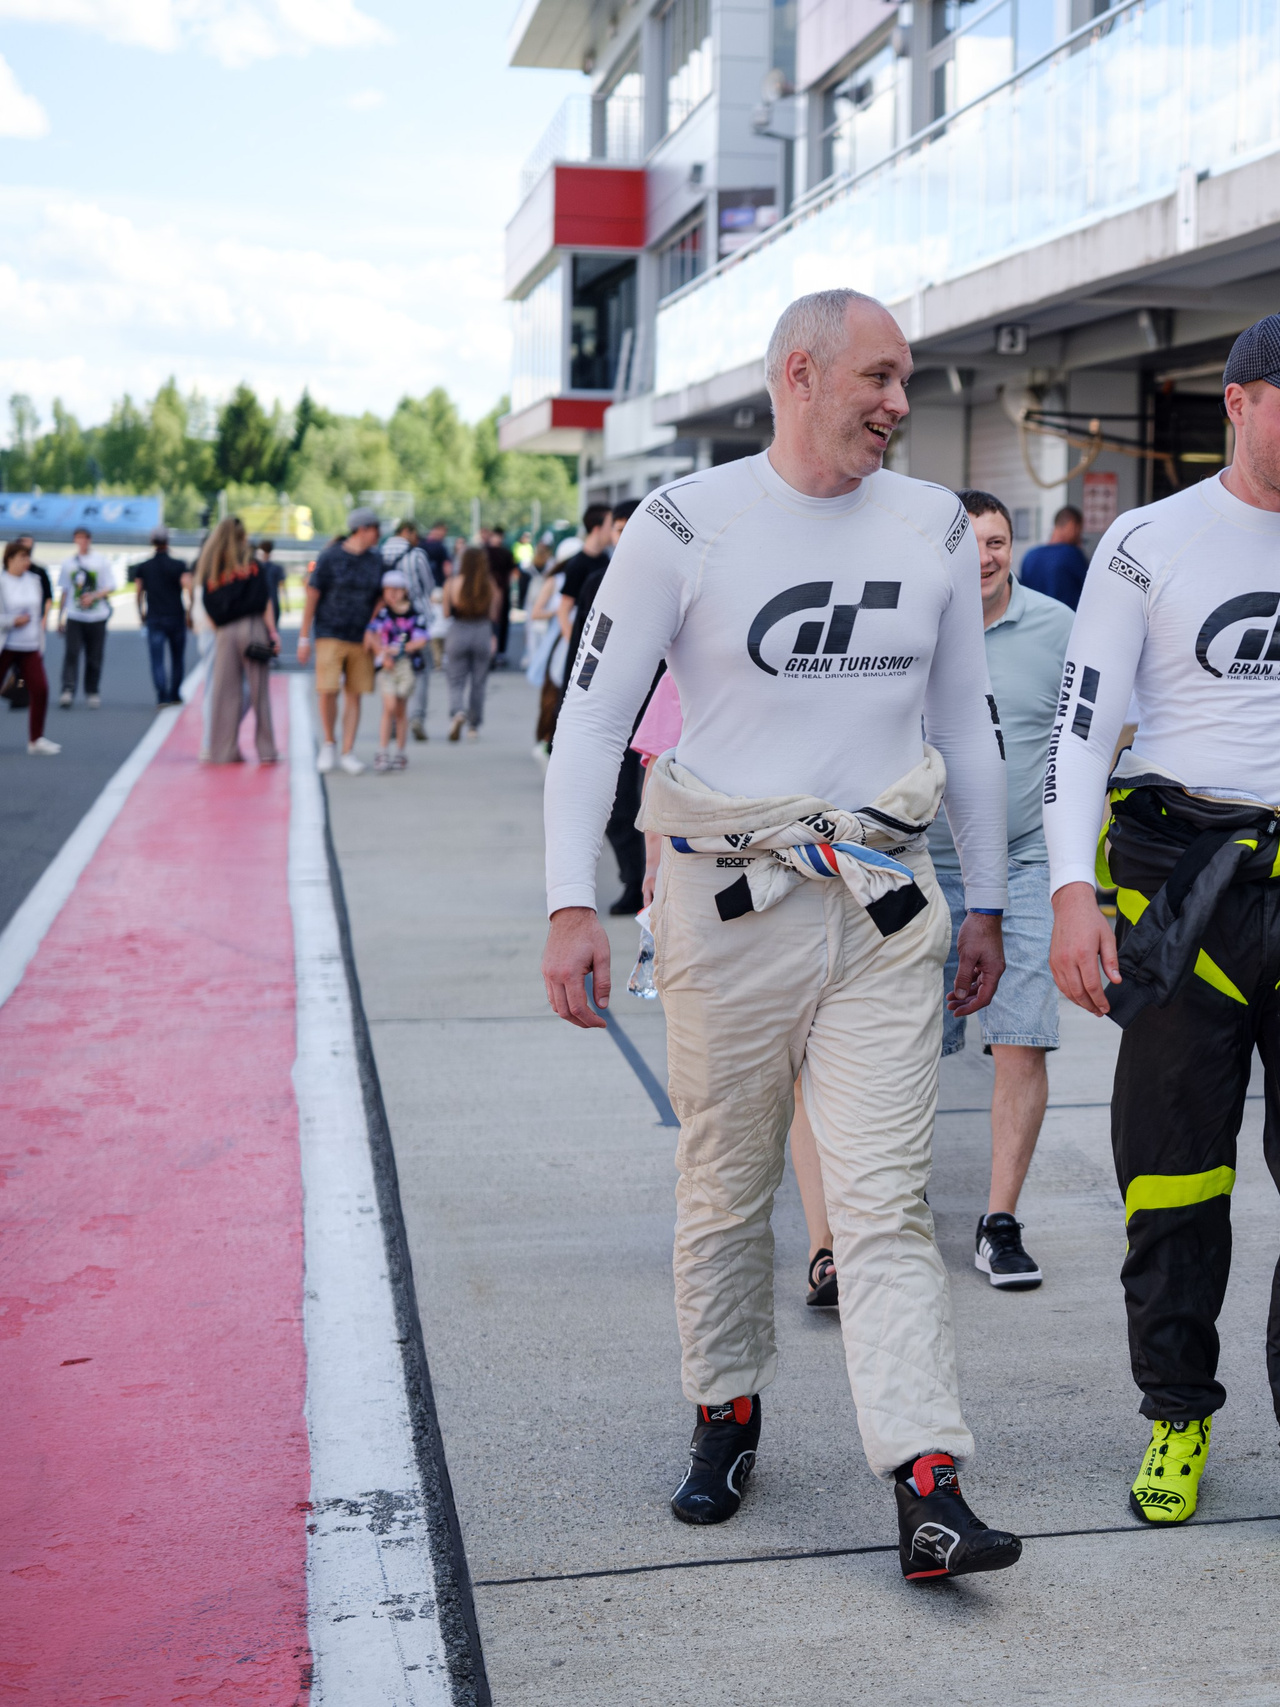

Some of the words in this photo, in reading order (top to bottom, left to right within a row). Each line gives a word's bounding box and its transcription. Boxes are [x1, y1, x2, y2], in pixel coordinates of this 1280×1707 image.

[646, 500, 694, 545] sparco
[785, 657, 833, 672] GRAN
[839, 656, 914, 672] TURISMO
[863, 670, 907, 678] SIMULATOR
[1228, 662, 1273, 675] GRAN
[1057, 661, 1076, 717] GRAN
[1044, 723, 1064, 805] TURISMO
